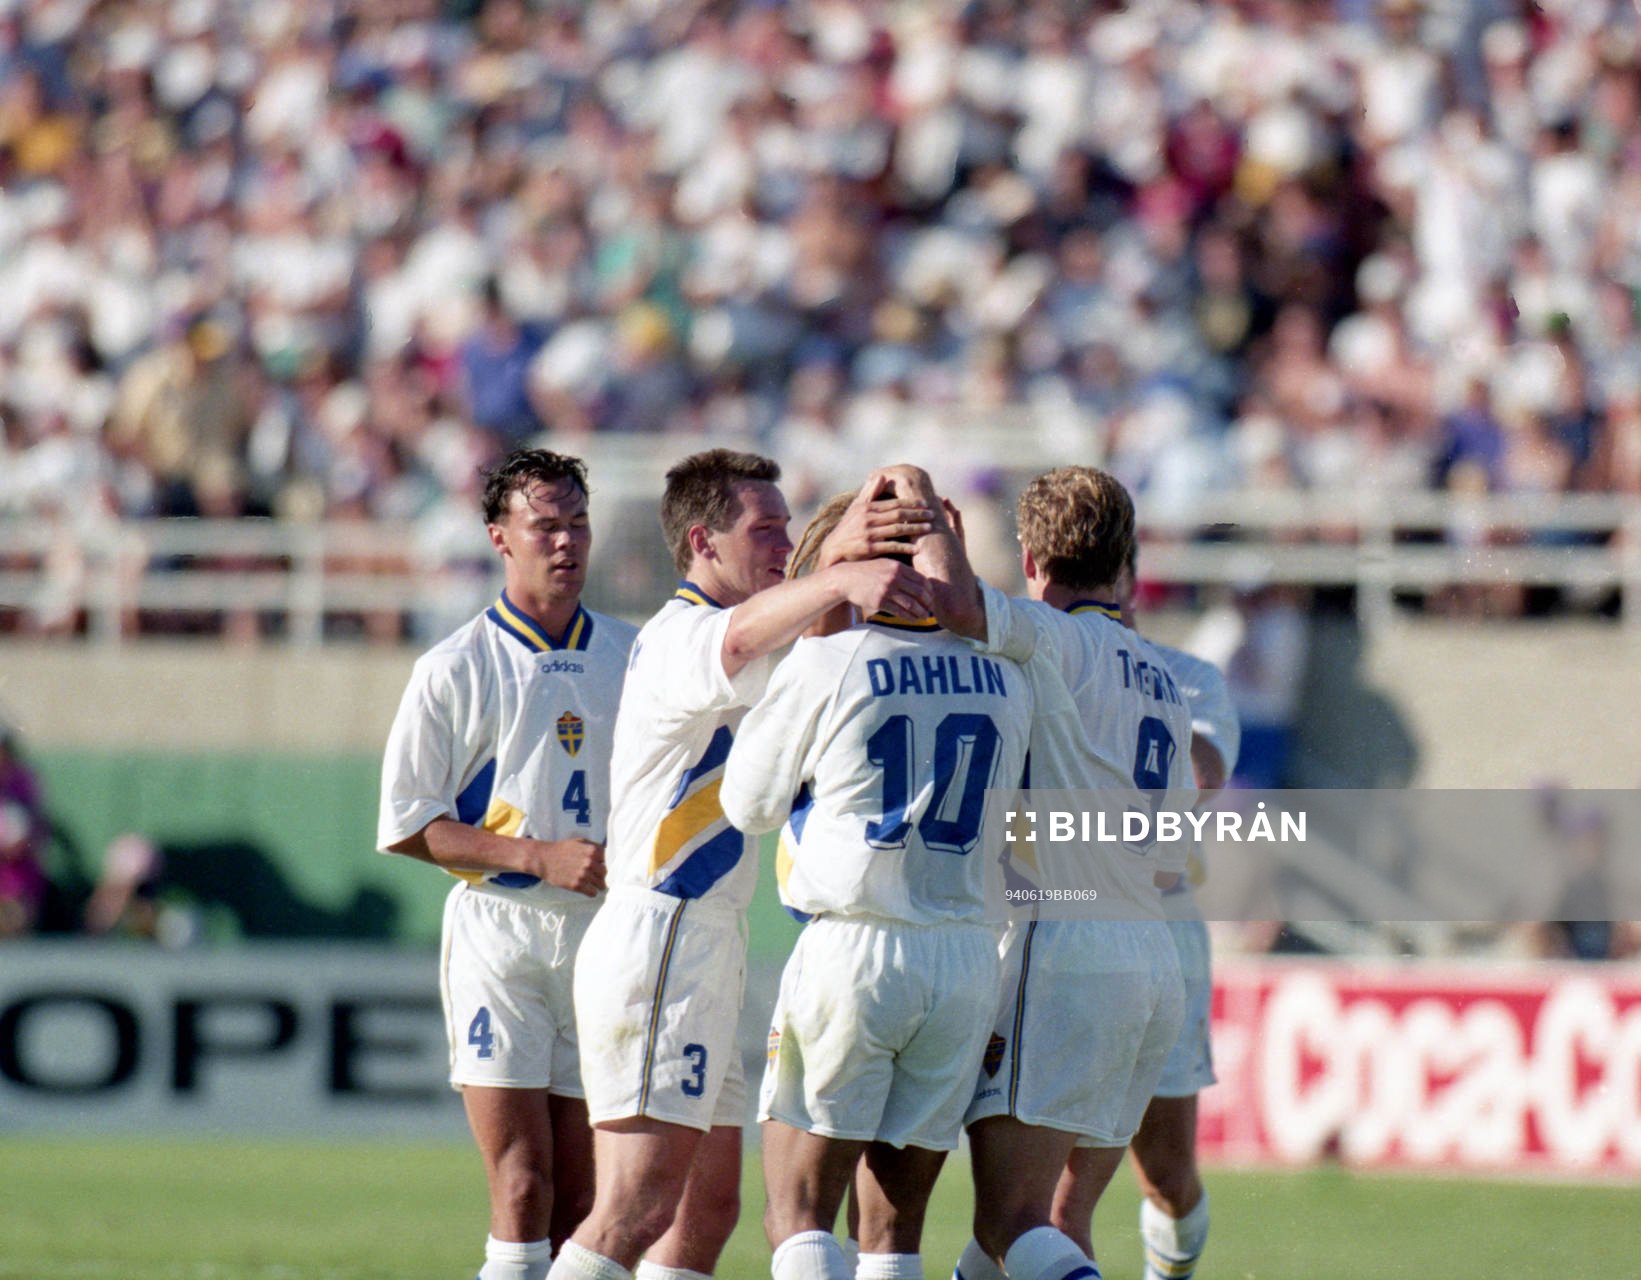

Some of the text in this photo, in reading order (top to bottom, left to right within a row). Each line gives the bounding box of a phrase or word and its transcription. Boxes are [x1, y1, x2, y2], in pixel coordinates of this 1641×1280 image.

[541, 660, 585, 673] adidas
[867, 655, 1008, 697] DAHLIN
[562, 769, 591, 827] 4
[865, 713, 1003, 855] 10
[1123, 716, 1177, 856] 9
[467, 1006, 496, 1060] 4
[681, 1043, 708, 1097] 3
